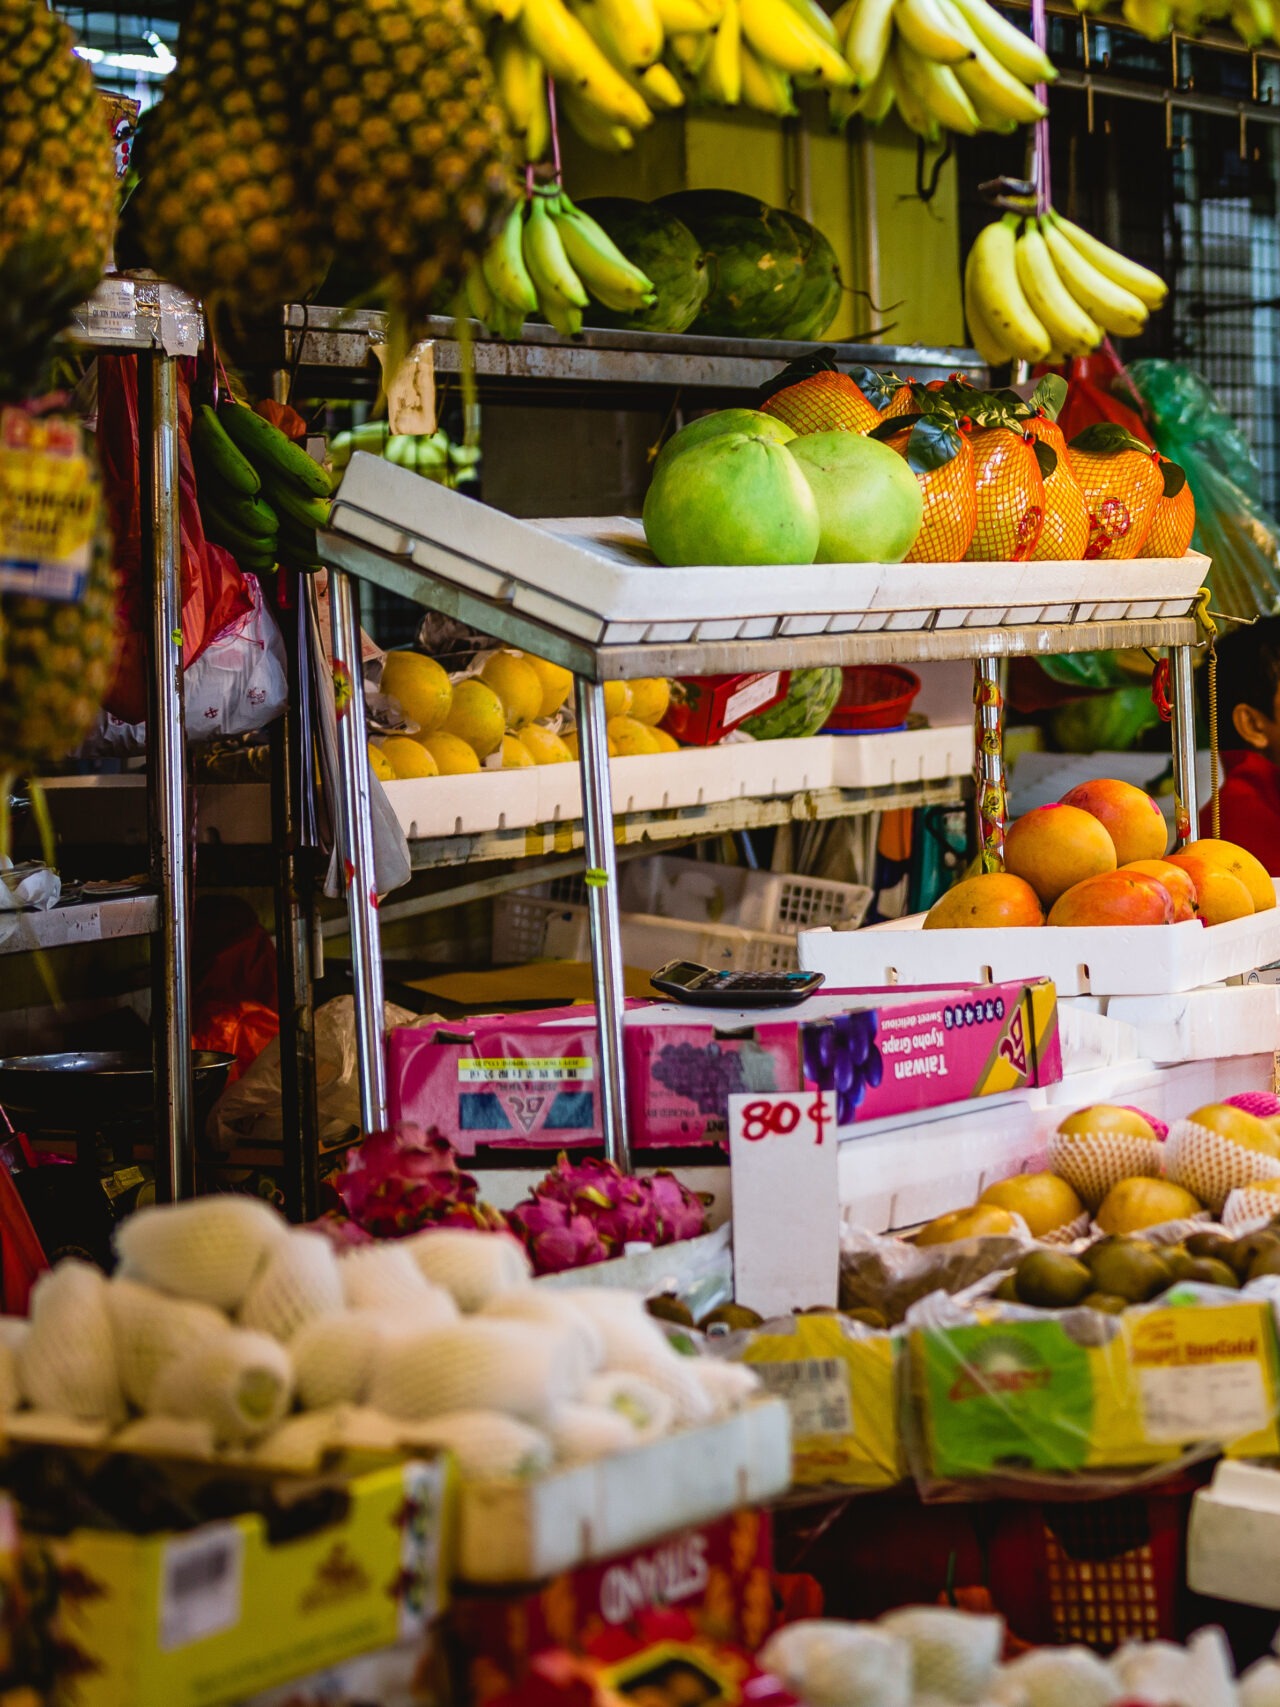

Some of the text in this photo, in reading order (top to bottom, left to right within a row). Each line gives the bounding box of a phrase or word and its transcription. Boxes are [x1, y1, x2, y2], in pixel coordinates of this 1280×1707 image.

[881, 1010, 942, 1031] Sweet delicious
[882, 1027, 945, 1054] Kyoho Grape
[894, 1054, 948, 1080] Taiwan
[741, 1089, 832, 1145] 80¢
